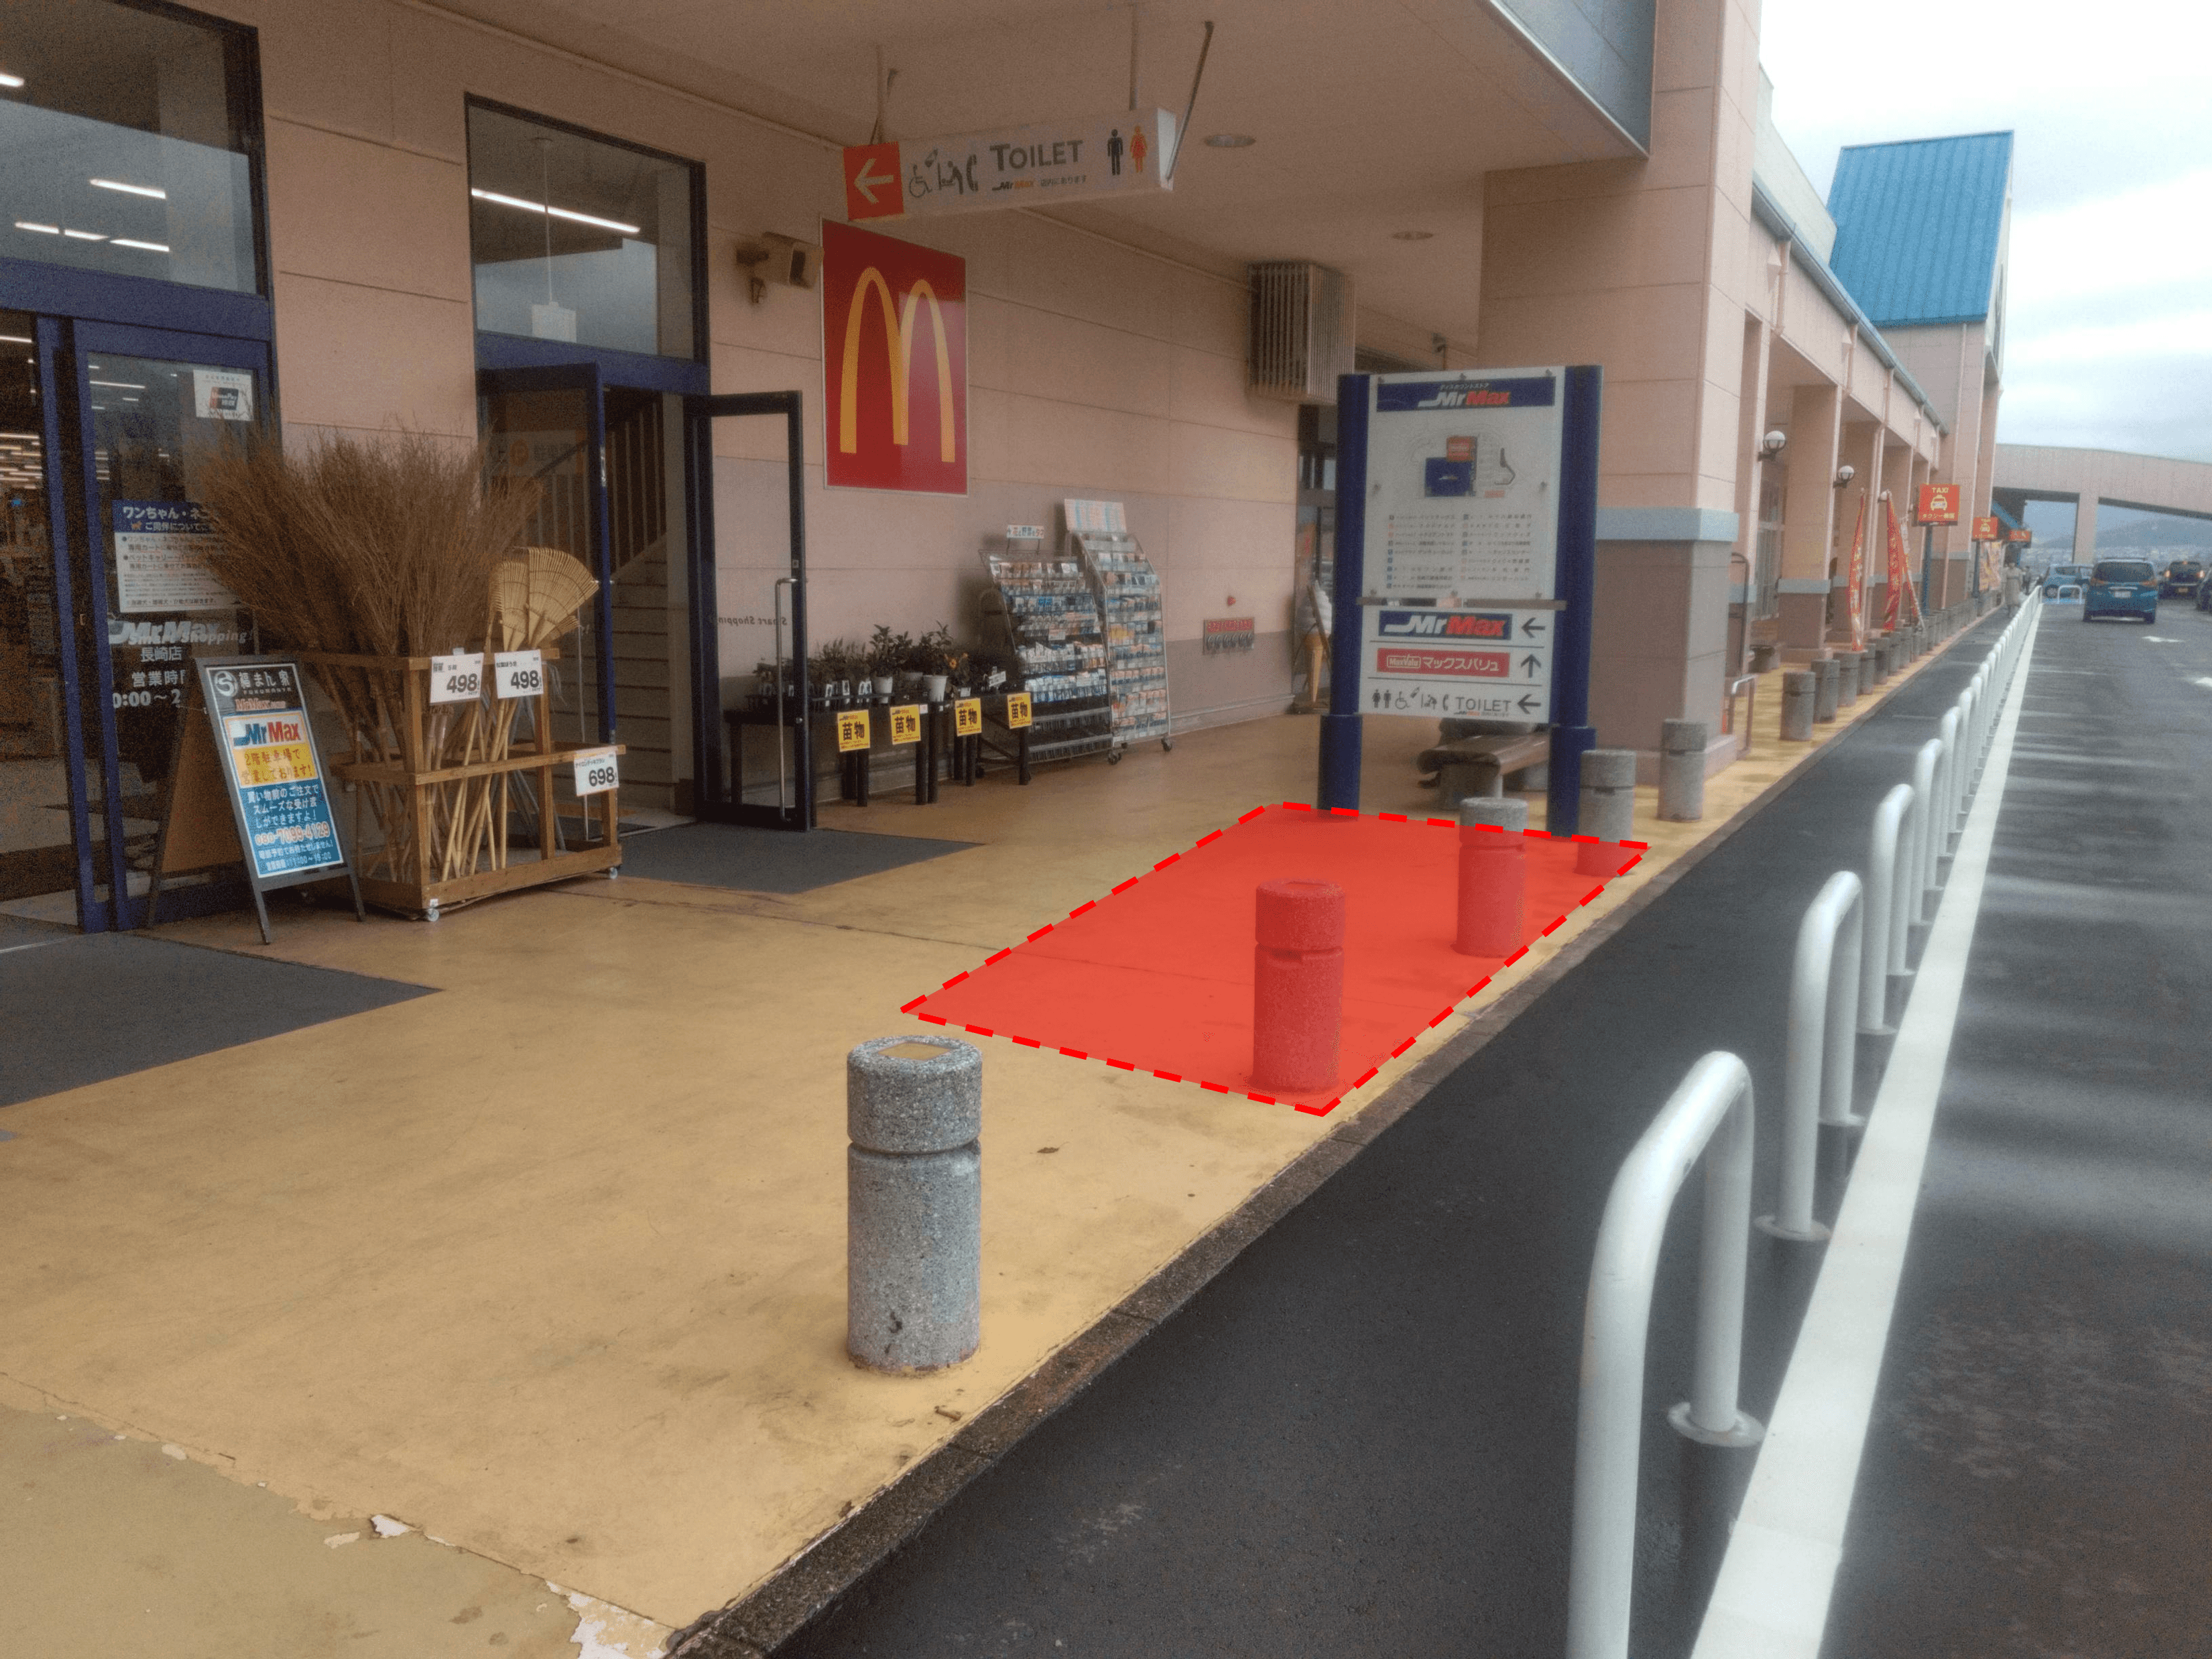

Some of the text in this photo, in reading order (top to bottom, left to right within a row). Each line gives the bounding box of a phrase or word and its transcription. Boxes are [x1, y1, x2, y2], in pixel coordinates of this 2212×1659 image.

[989, 140, 1083, 172] TOILET
[1418, 390, 1510, 407] MrMax
[1384, 615, 1506, 636] MrMax
[141, 646, 182, 662] 長崎店
[1422, 656, 1499, 672] マックスバリュ
[238, 670, 290, 689] 福まん家
[446, 673, 478, 693] 498
[510, 670, 540, 690] 498
[1011, 701, 1028, 719] 苗物
[1455, 696, 1512, 712] TOILET
[894, 715, 916, 734] 苗物
[958, 707, 977, 727] 苗物
[233, 721, 301, 745] MrMax
[842, 721, 865, 741] 苗物
[589, 766, 615, 787] 698
[255, 821, 330, 846] 080-7099-4129
